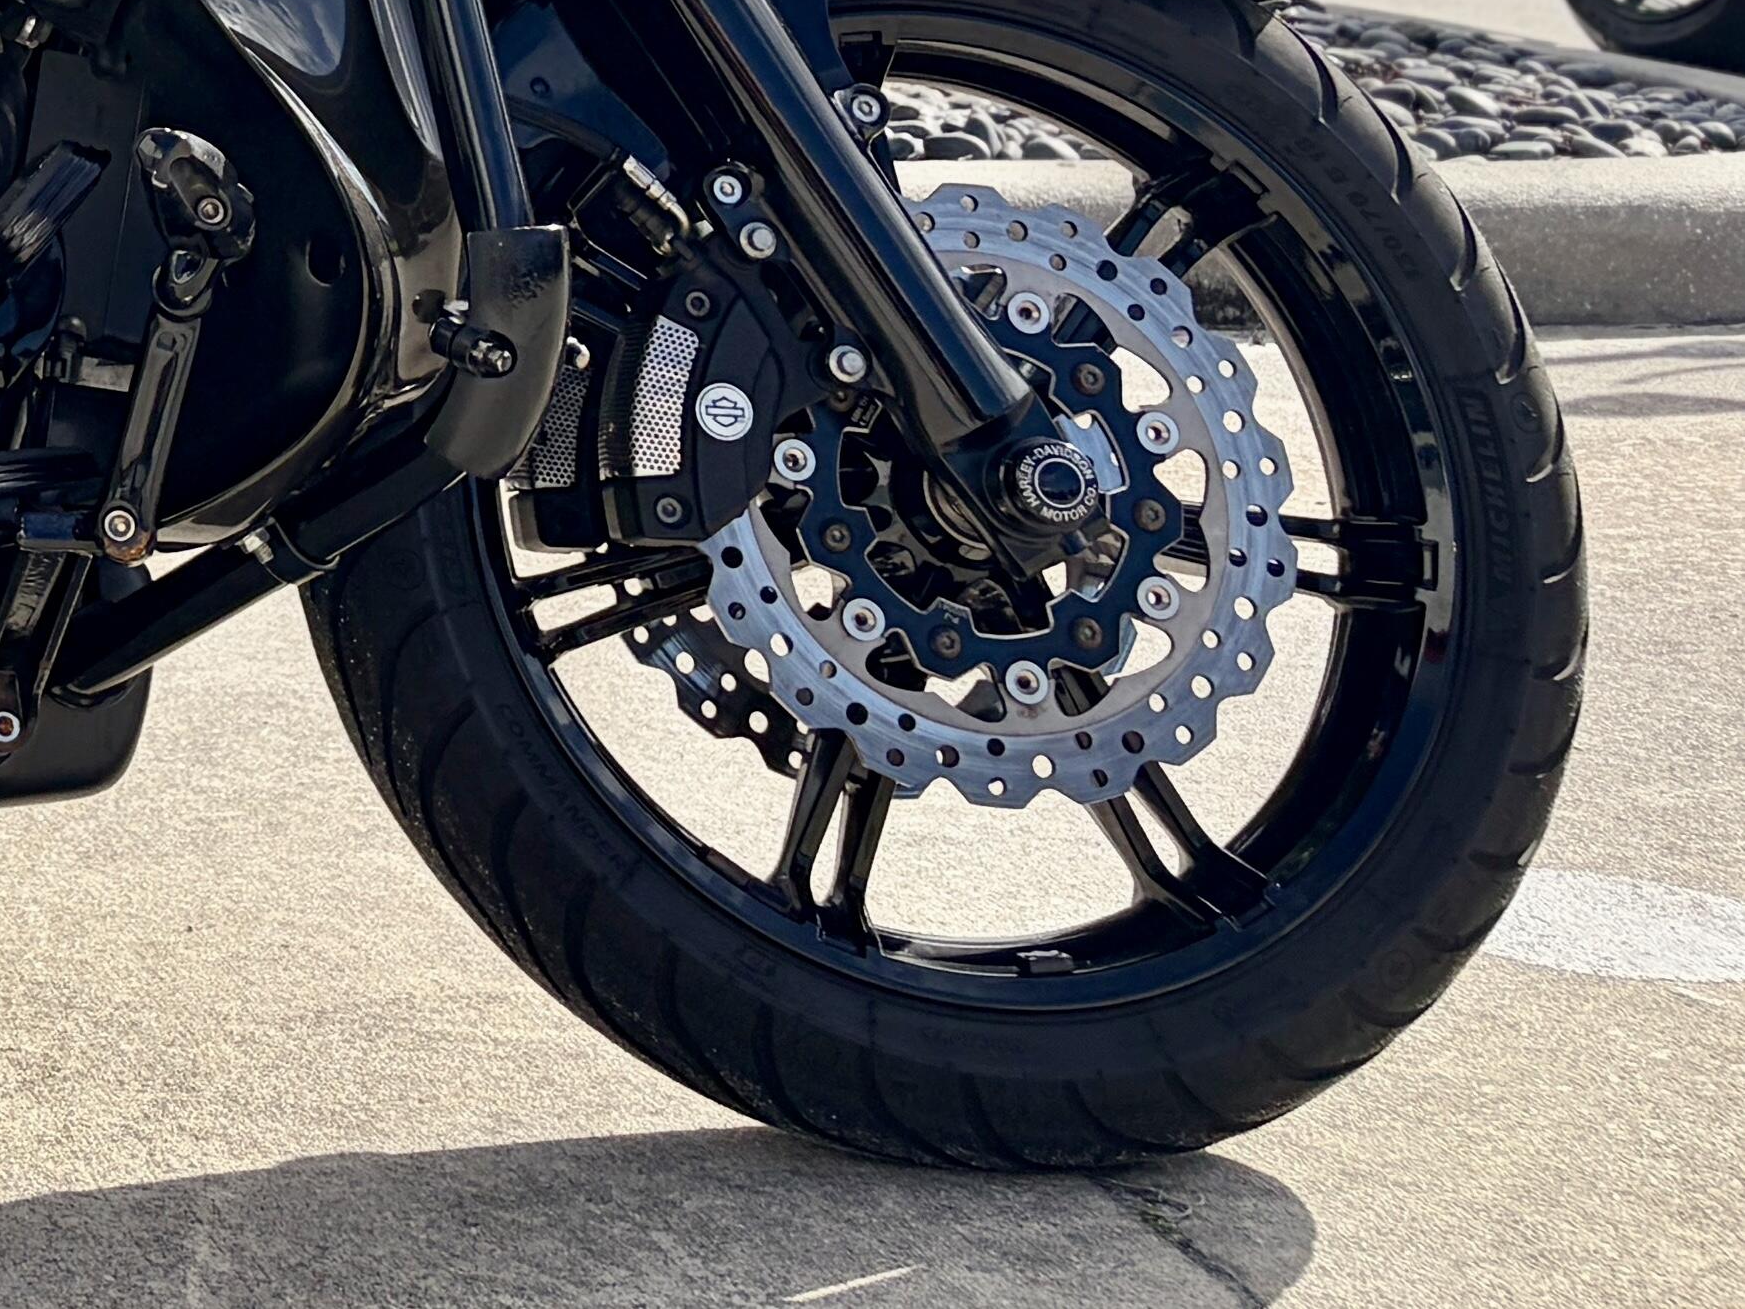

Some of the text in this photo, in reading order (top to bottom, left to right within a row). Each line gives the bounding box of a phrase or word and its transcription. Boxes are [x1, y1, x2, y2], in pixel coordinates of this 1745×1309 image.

[1018, 445, 1095, 508] HARLEY-DAVIDSON
[1039, 504, 1088, 522] MOTOR
[1462, 392, 1513, 583] MICHELIN
[496, 703, 628, 868] COMMANDER
